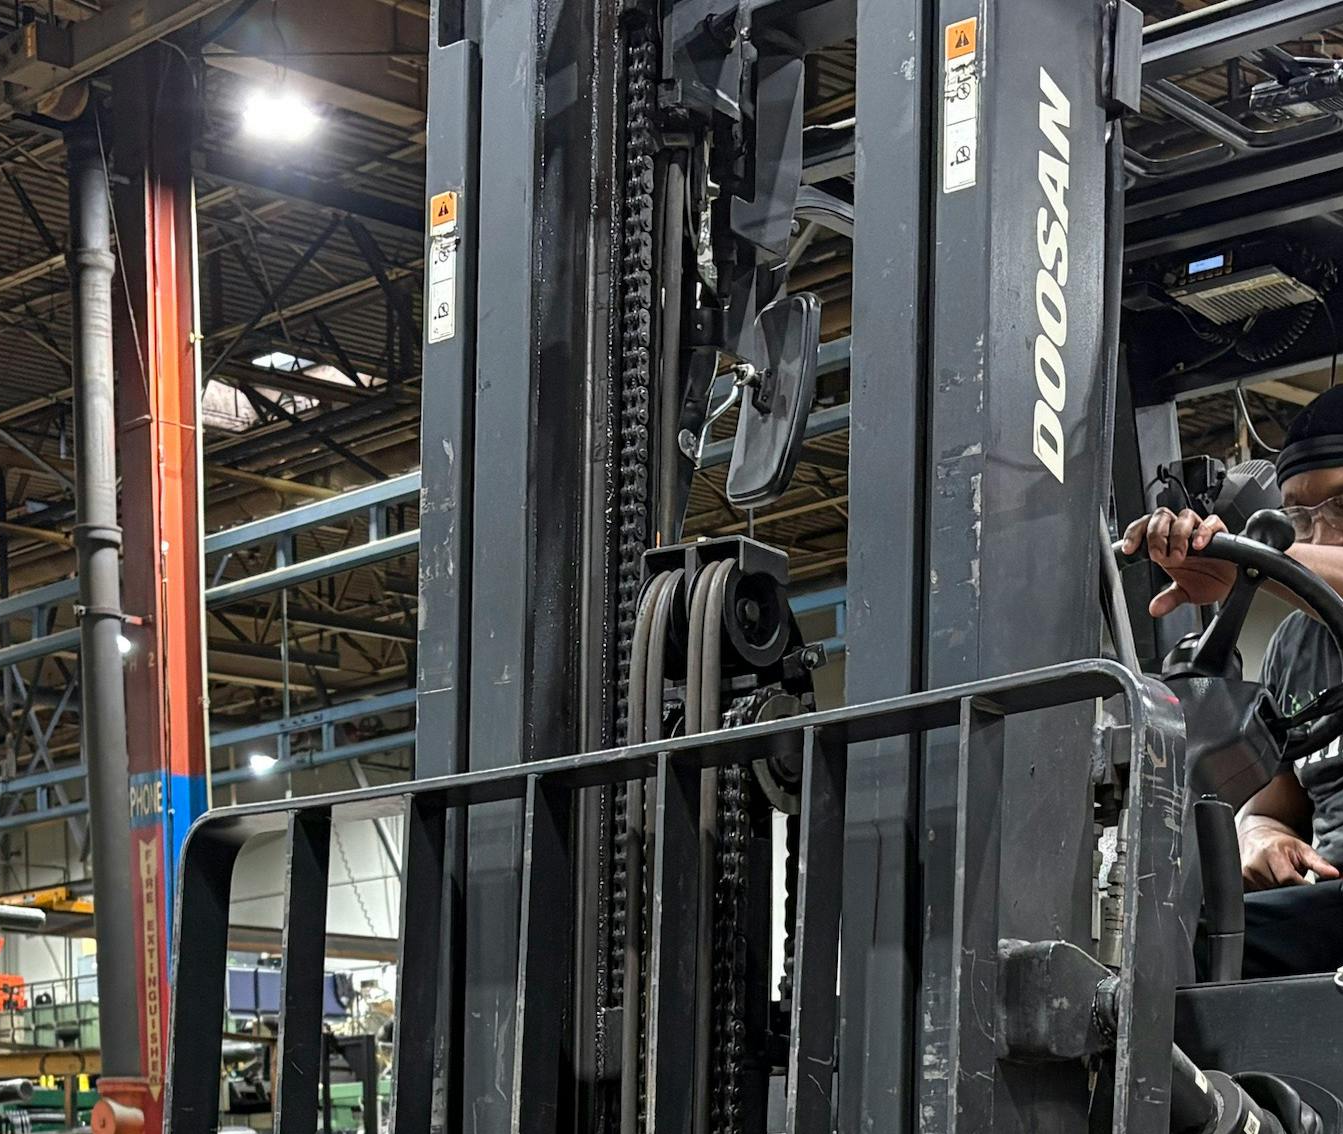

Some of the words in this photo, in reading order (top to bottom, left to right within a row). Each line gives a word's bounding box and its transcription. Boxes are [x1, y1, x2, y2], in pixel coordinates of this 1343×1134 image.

[1033, 66, 1071, 484] DOOSAN
[130, 781, 163, 818] PHONE
[144, 851, 154, 903] FIRE
[146, 920, 159, 1085] EXTINGUISHER
